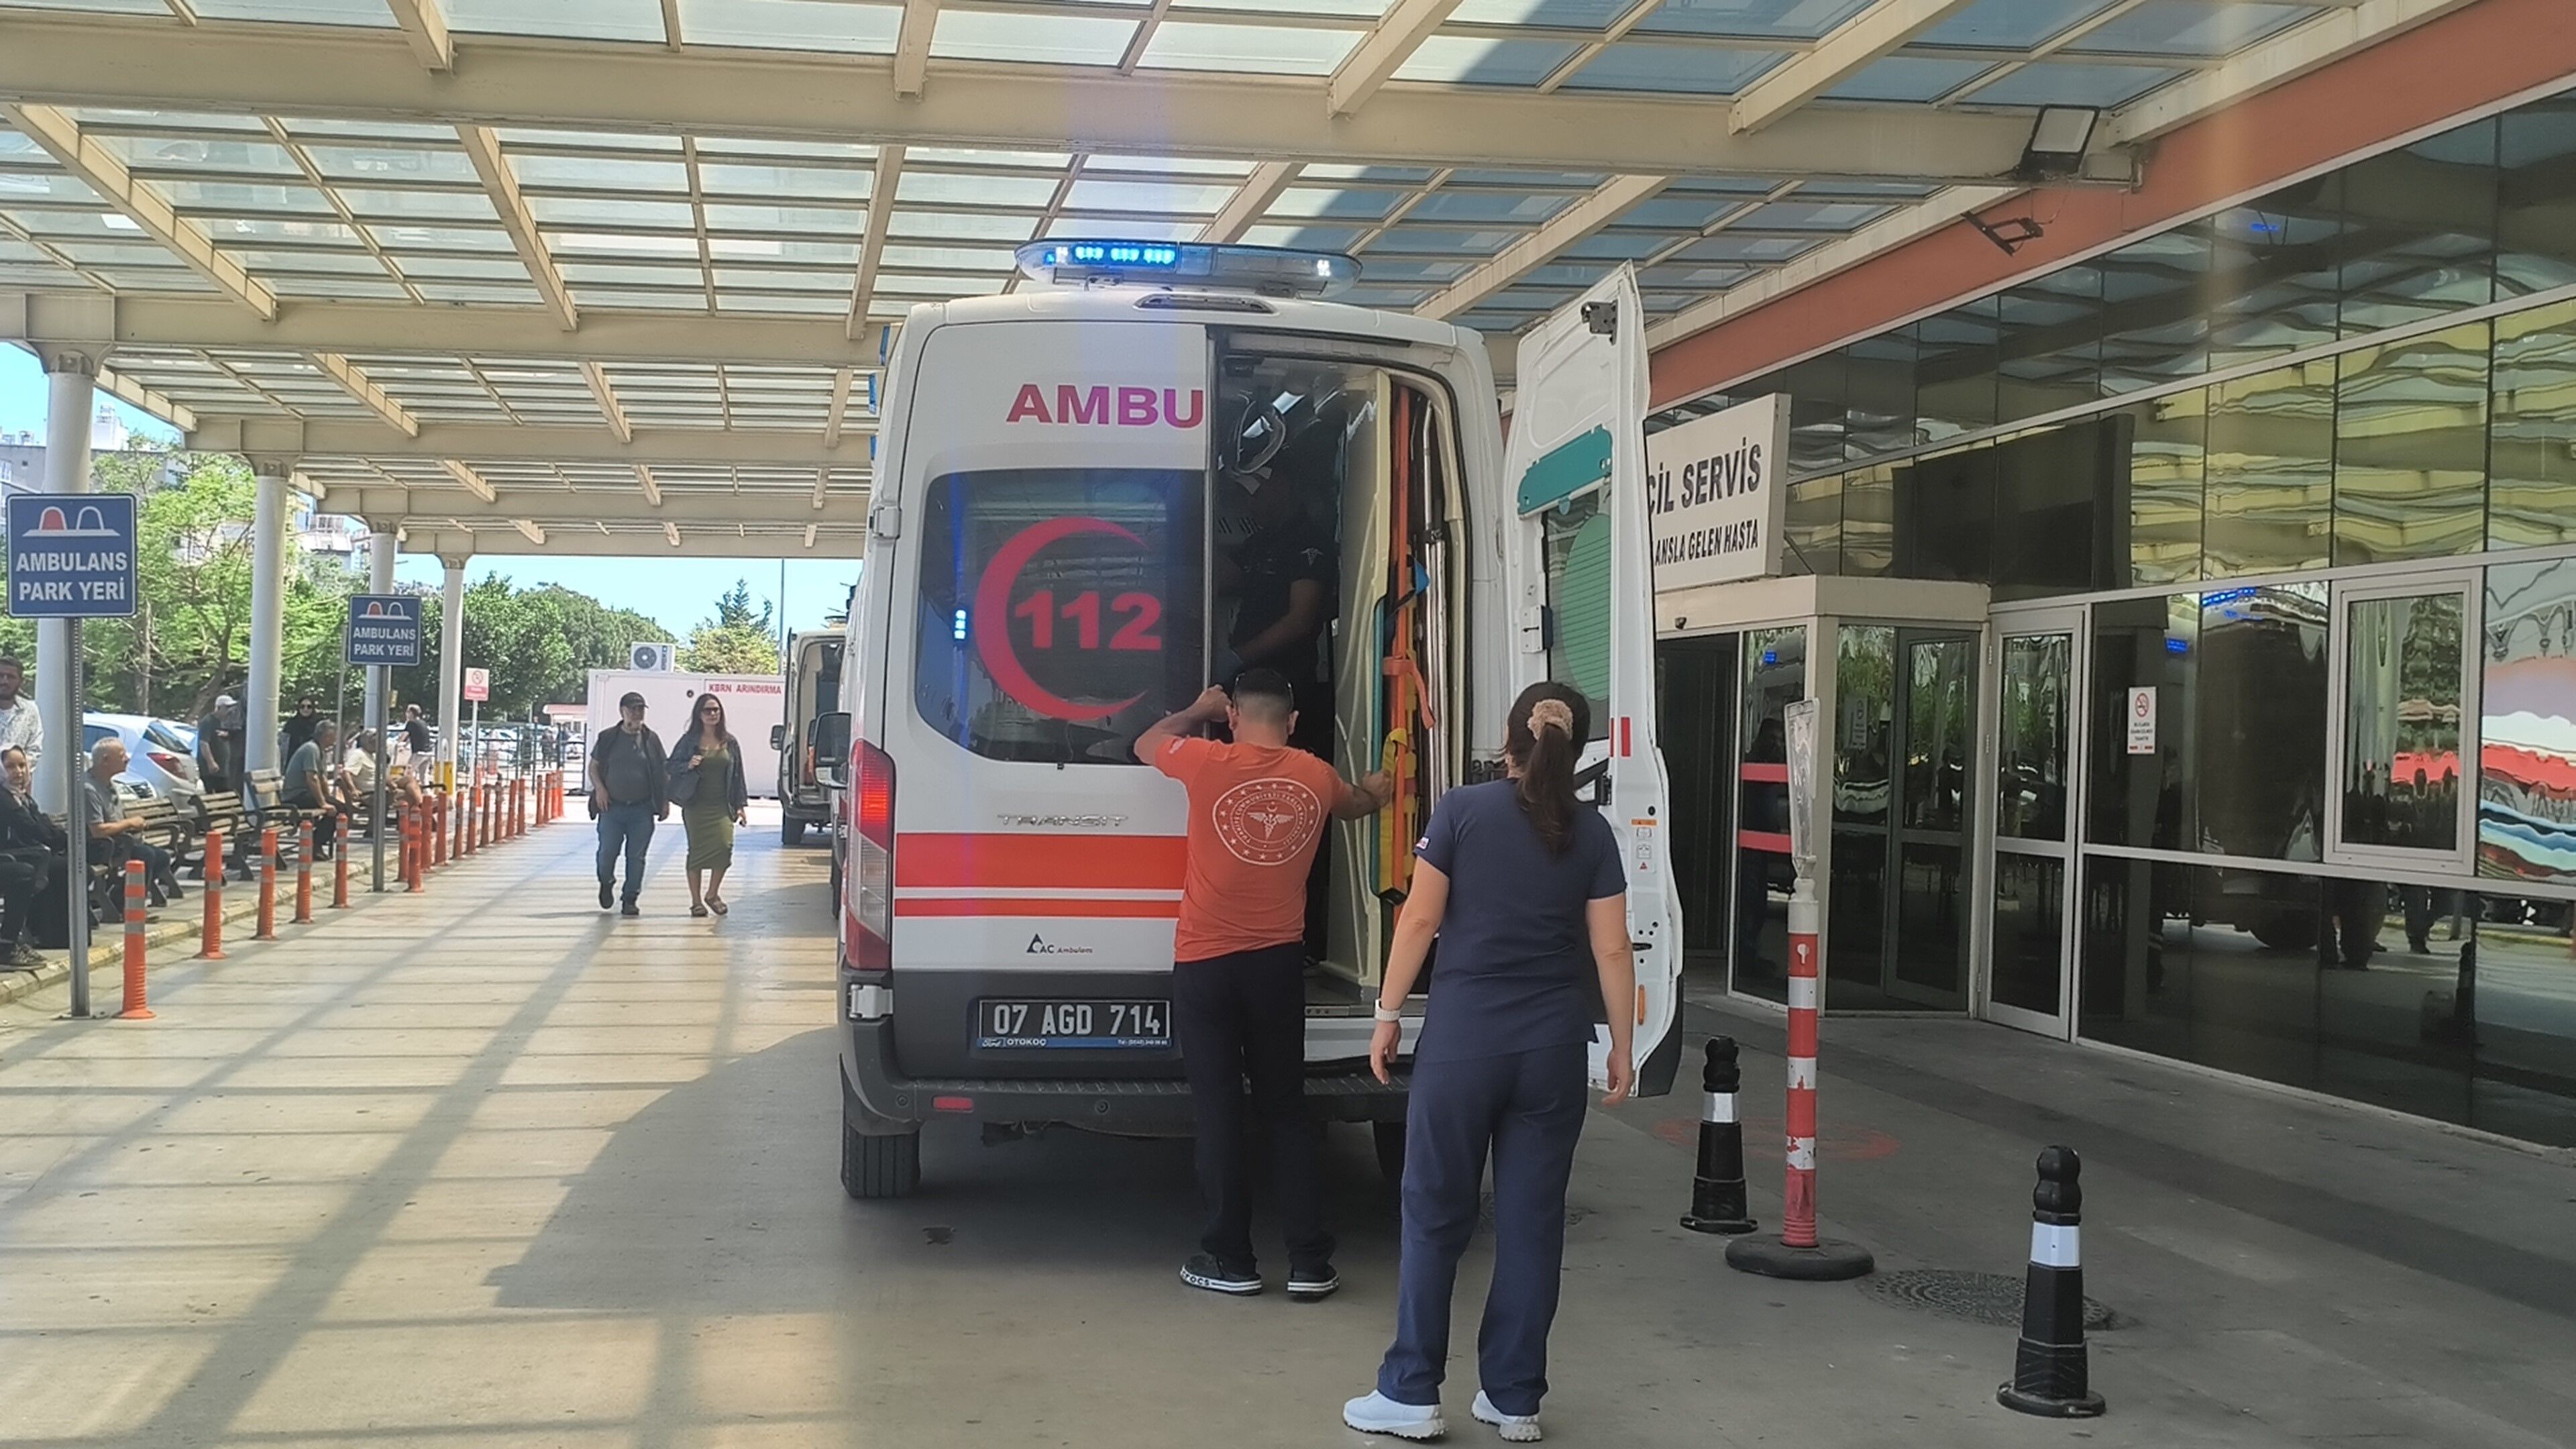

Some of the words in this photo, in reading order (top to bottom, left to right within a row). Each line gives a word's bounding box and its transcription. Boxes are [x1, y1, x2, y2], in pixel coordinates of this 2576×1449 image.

[1006, 383, 1204, 429] AMBU
[1681, 437, 1762, 508] SERVİS
[1655, 535, 1685, 566] ANSLA
[1688, 527, 1723, 561] GELEN
[1723, 519, 1758, 553] HASTA
[15, 551, 128, 572] AMBULANS
[19, 581, 73, 601] PARK
[78, 576, 126, 601] YERİ
[1014, 590, 1163, 651] 112
[353, 626, 416, 641] AMBULANS
[354, 643, 384, 656] PARK
[386, 640, 415, 656] YERİ
[998, 814, 1129, 827] TRANSIT
[1040, 944, 1055, 953] AC
[994, 1004, 1028, 1034] 07
[1040, 1004, 1093, 1034] AGD
[1110, 1004, 1161, 1035] 714
